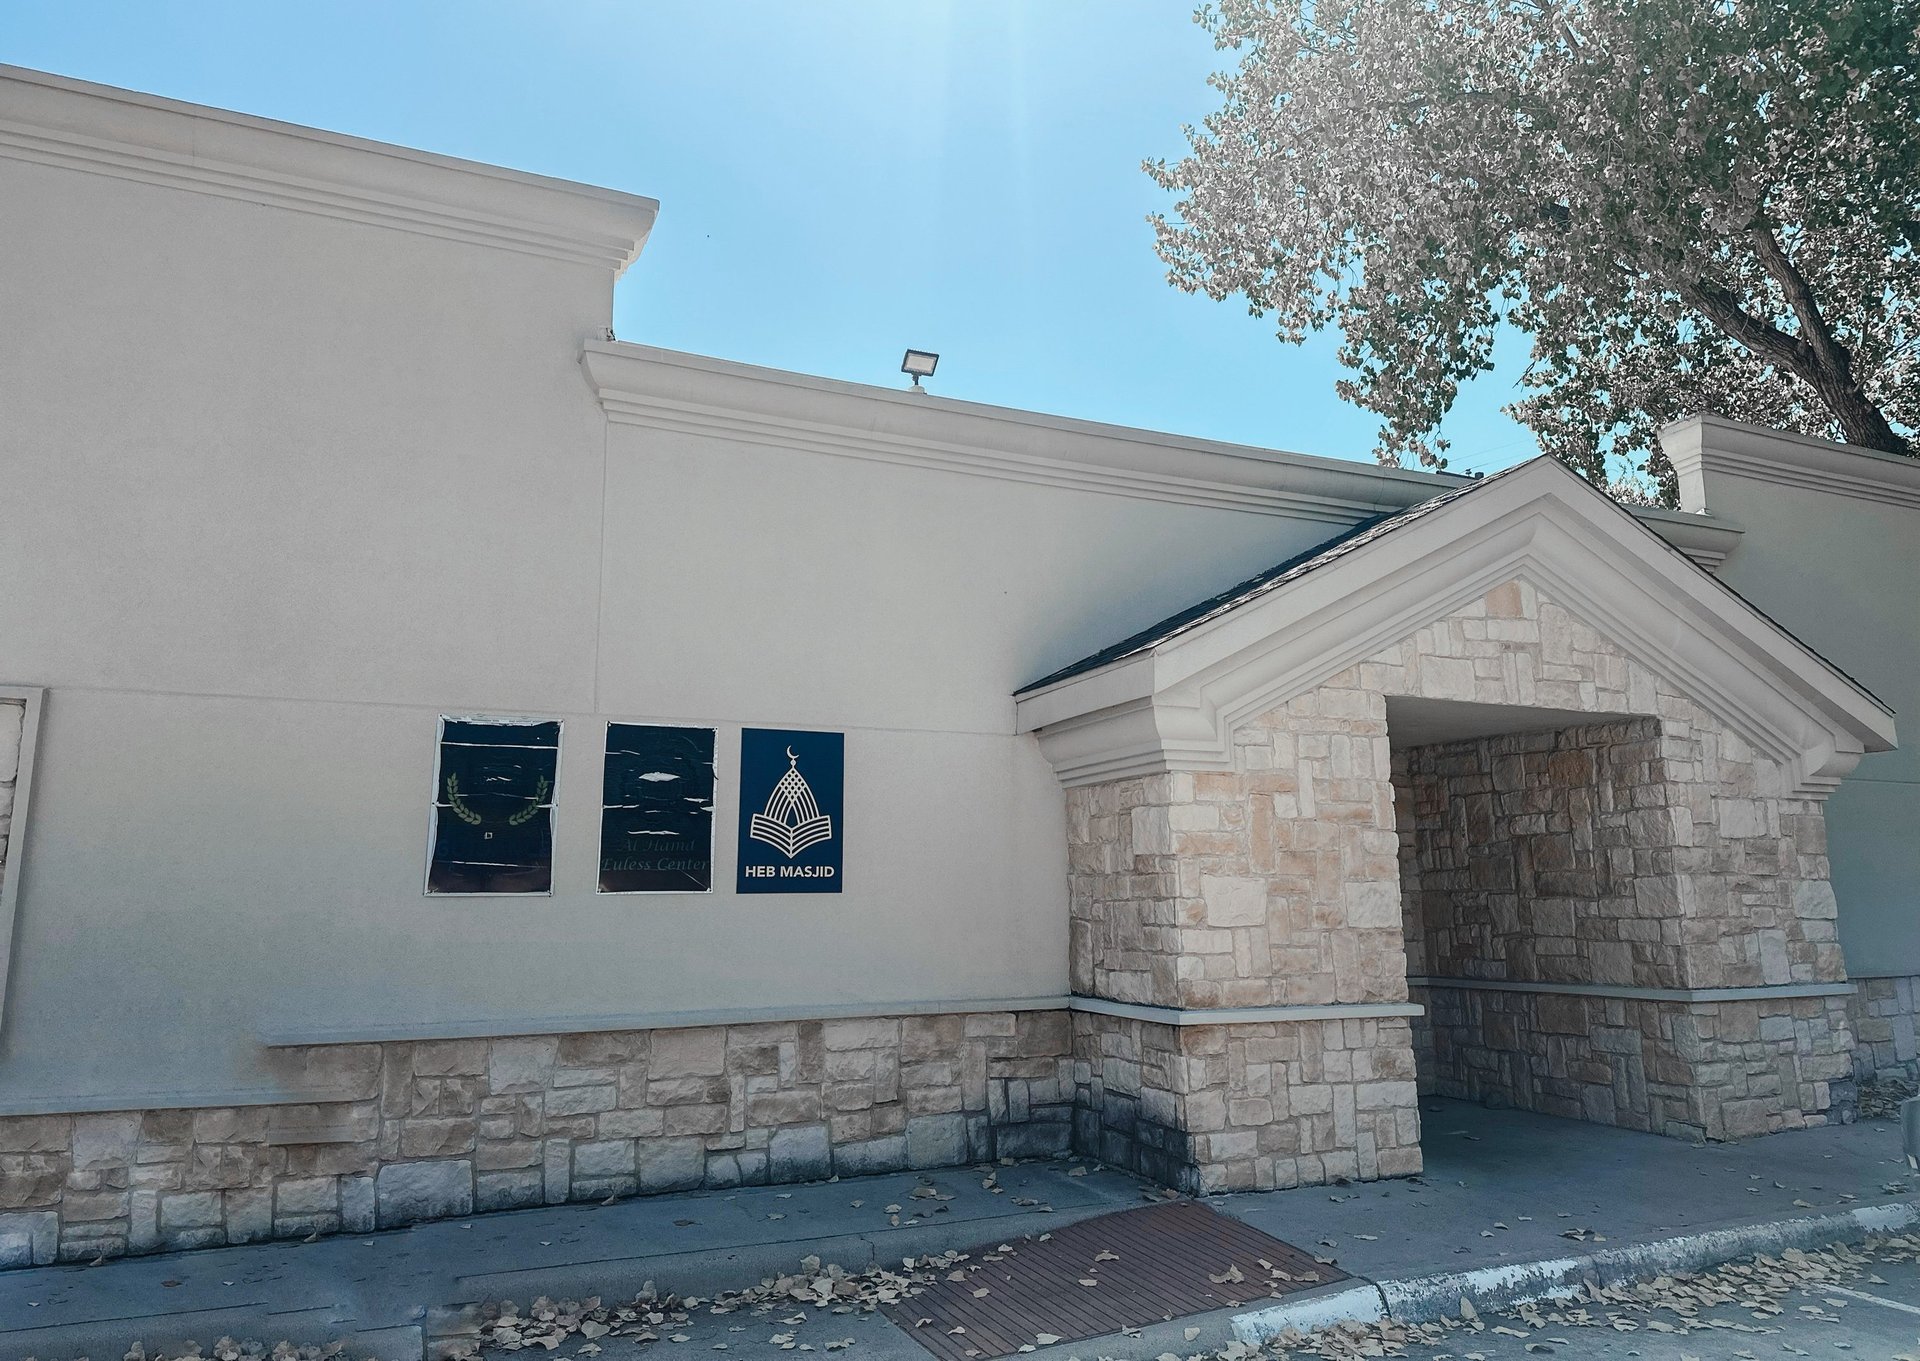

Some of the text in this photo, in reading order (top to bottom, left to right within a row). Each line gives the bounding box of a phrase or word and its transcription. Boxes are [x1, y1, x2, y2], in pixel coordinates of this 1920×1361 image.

[657, 857, 708, 871] Center
[745, 865, 835, 878] HEB MASJID
